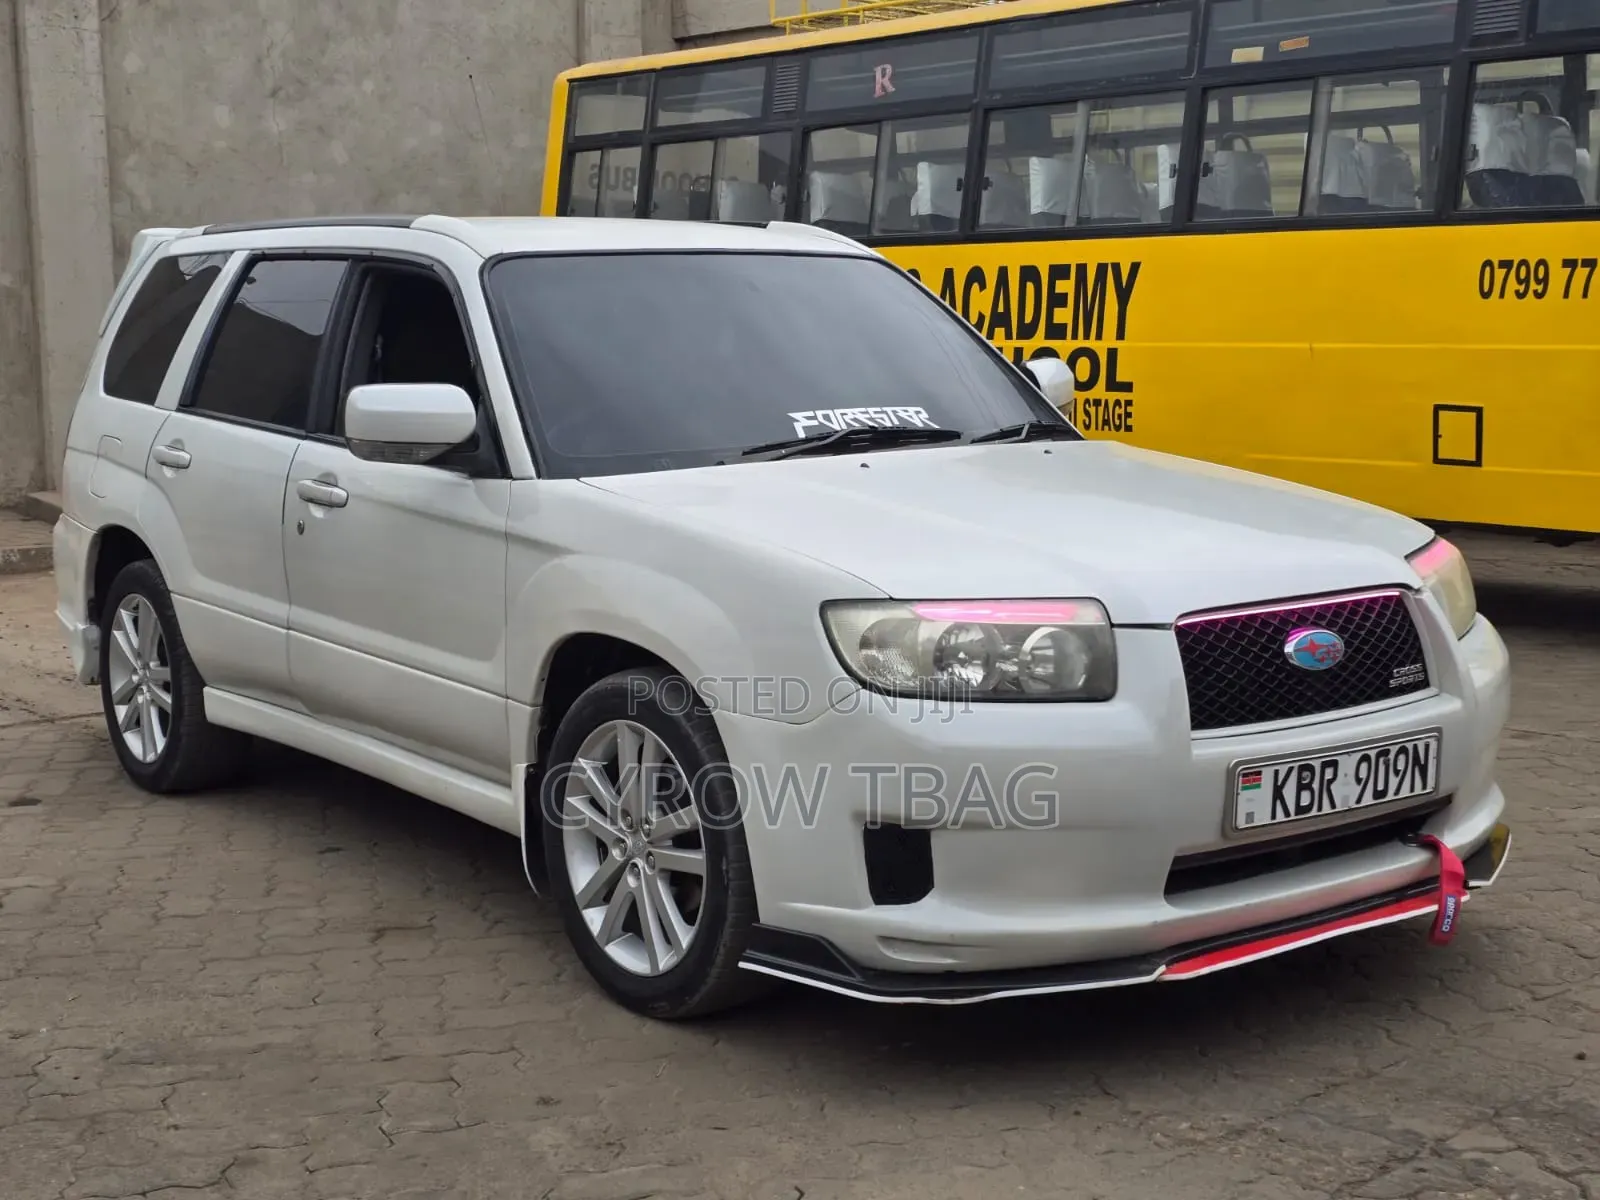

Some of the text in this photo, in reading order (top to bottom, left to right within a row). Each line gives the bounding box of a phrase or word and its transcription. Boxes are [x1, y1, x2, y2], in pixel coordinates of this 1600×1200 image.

[873, 64, 896, 98] R
[1478, 257, 1598, 300] 0799 77
[787, 406, 941, 439] FORESTER
[1082, 397, 1133, 432] STAGE
[1271, 741, 1430, 821] KBR 909N
